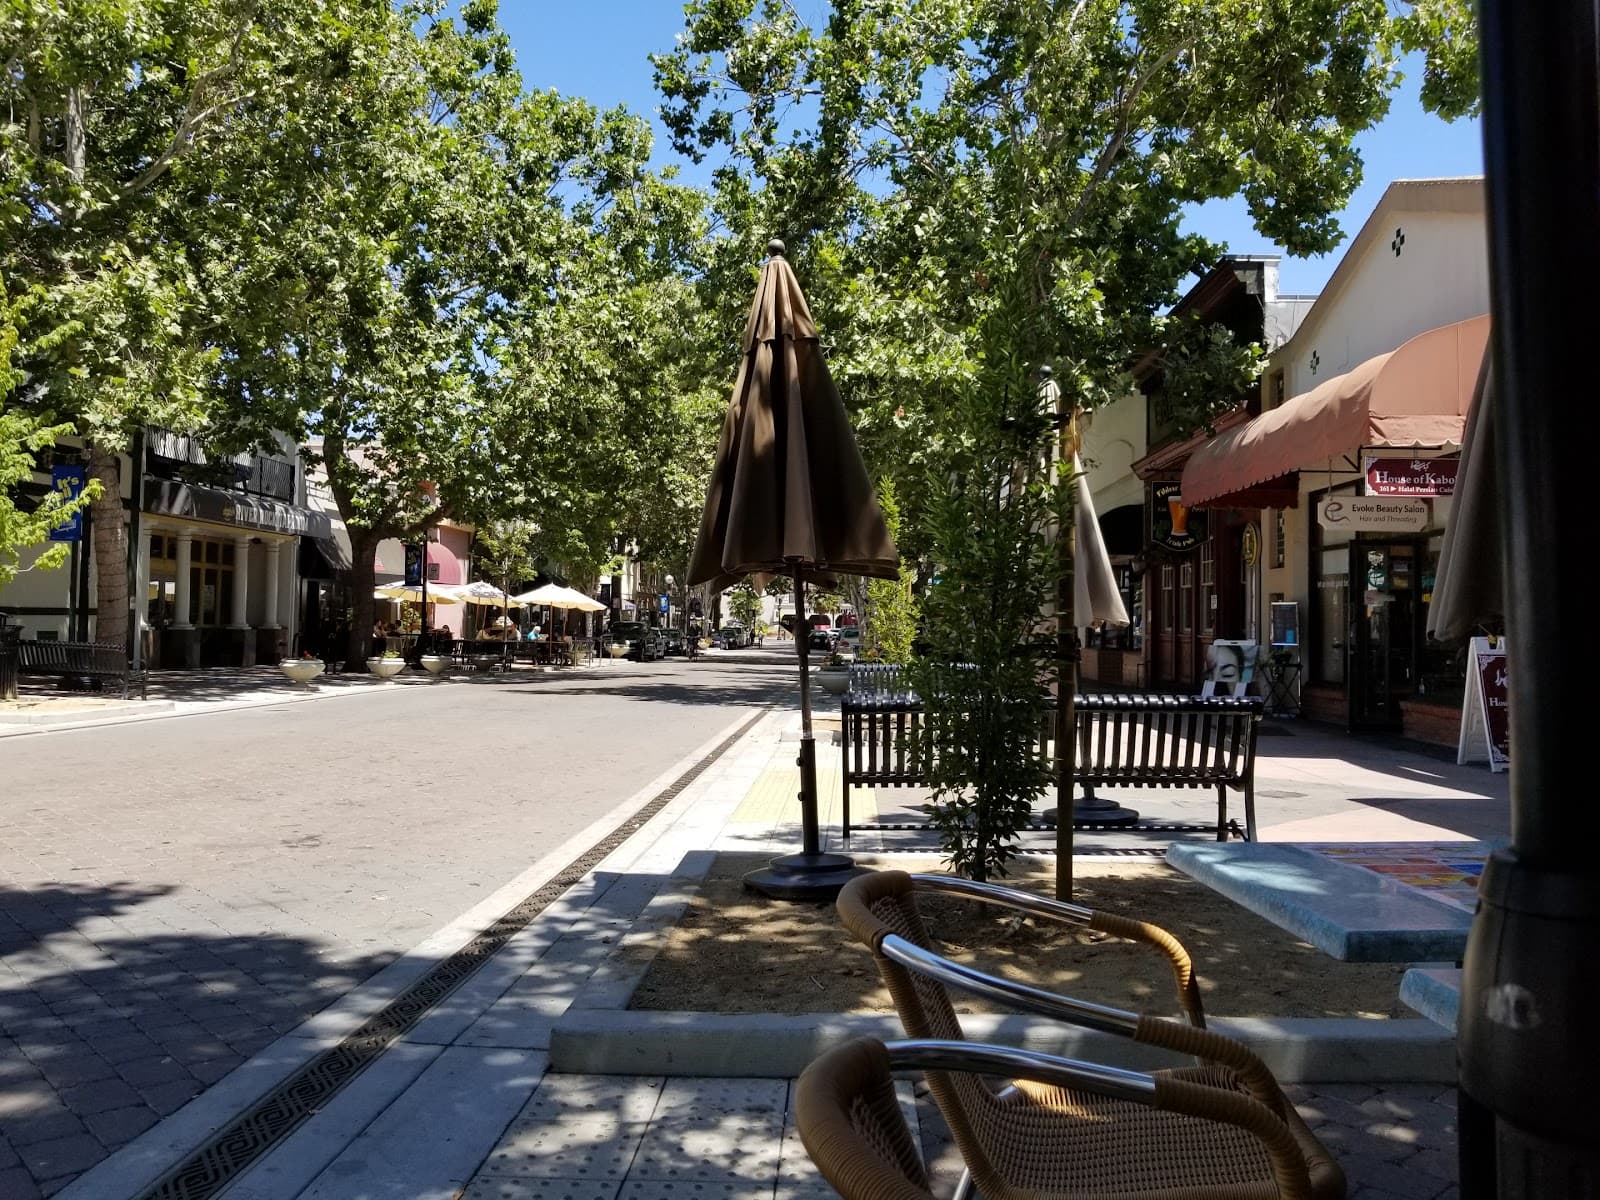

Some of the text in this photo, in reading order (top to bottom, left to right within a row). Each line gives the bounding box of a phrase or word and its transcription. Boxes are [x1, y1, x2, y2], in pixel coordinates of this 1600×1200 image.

[1375, 470, 1412, 484] House
[1413, 474, 1424, 484] of
[1352, 504, 1425, 514] Evoke Beauty Salon
